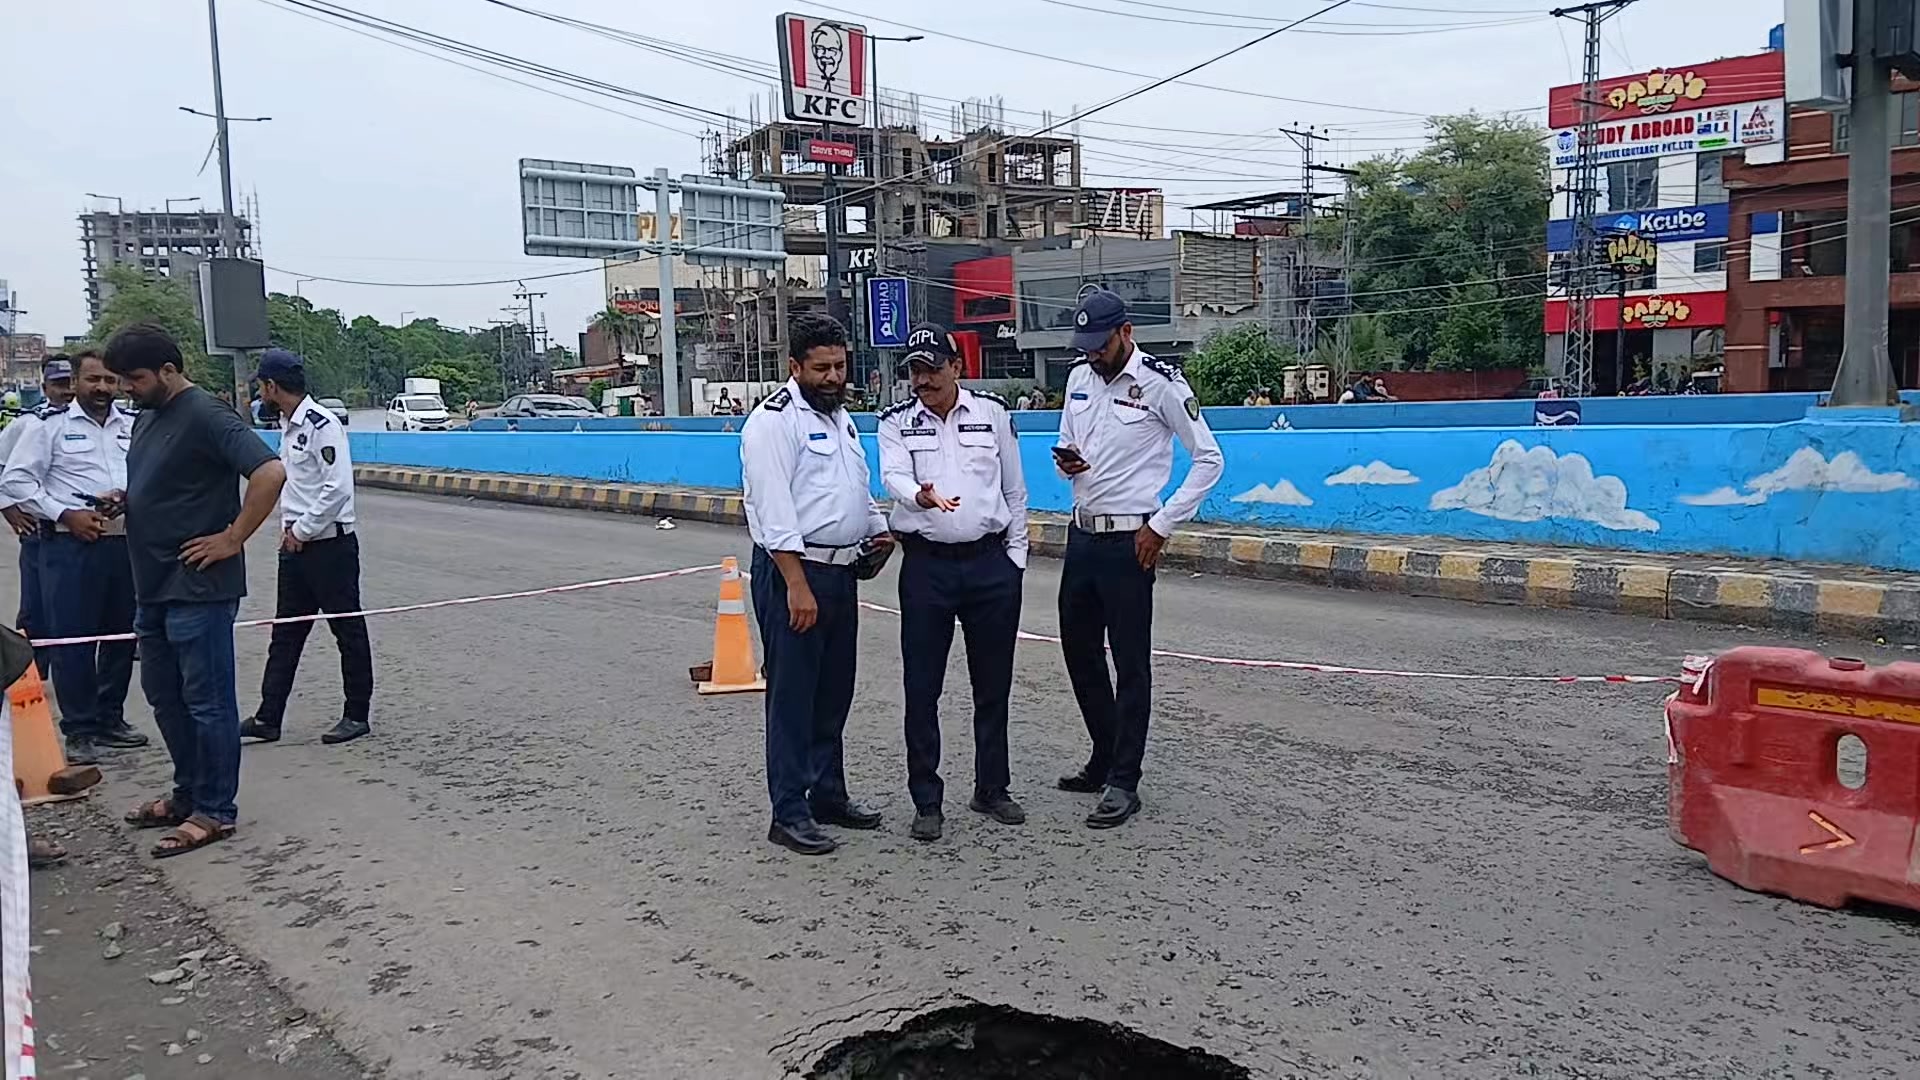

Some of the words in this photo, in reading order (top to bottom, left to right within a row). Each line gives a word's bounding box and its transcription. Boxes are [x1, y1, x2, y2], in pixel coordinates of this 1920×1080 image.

[1608, 70, 1706, 110] PAPA'S
[802, 94, 857, 119] KFC
[1631, 116, 1694, 141] ABROAD
[811, 145, 833, 156] DRIVE
[834, 147, 854, 158] THRU
[1640, 210, 1706, 231] Kcube
[879, 281, 891, 321] ETIHAD
[1623, 299, 1690, 323] PAPA'S
[908, 329, 939, 348] CTPL
